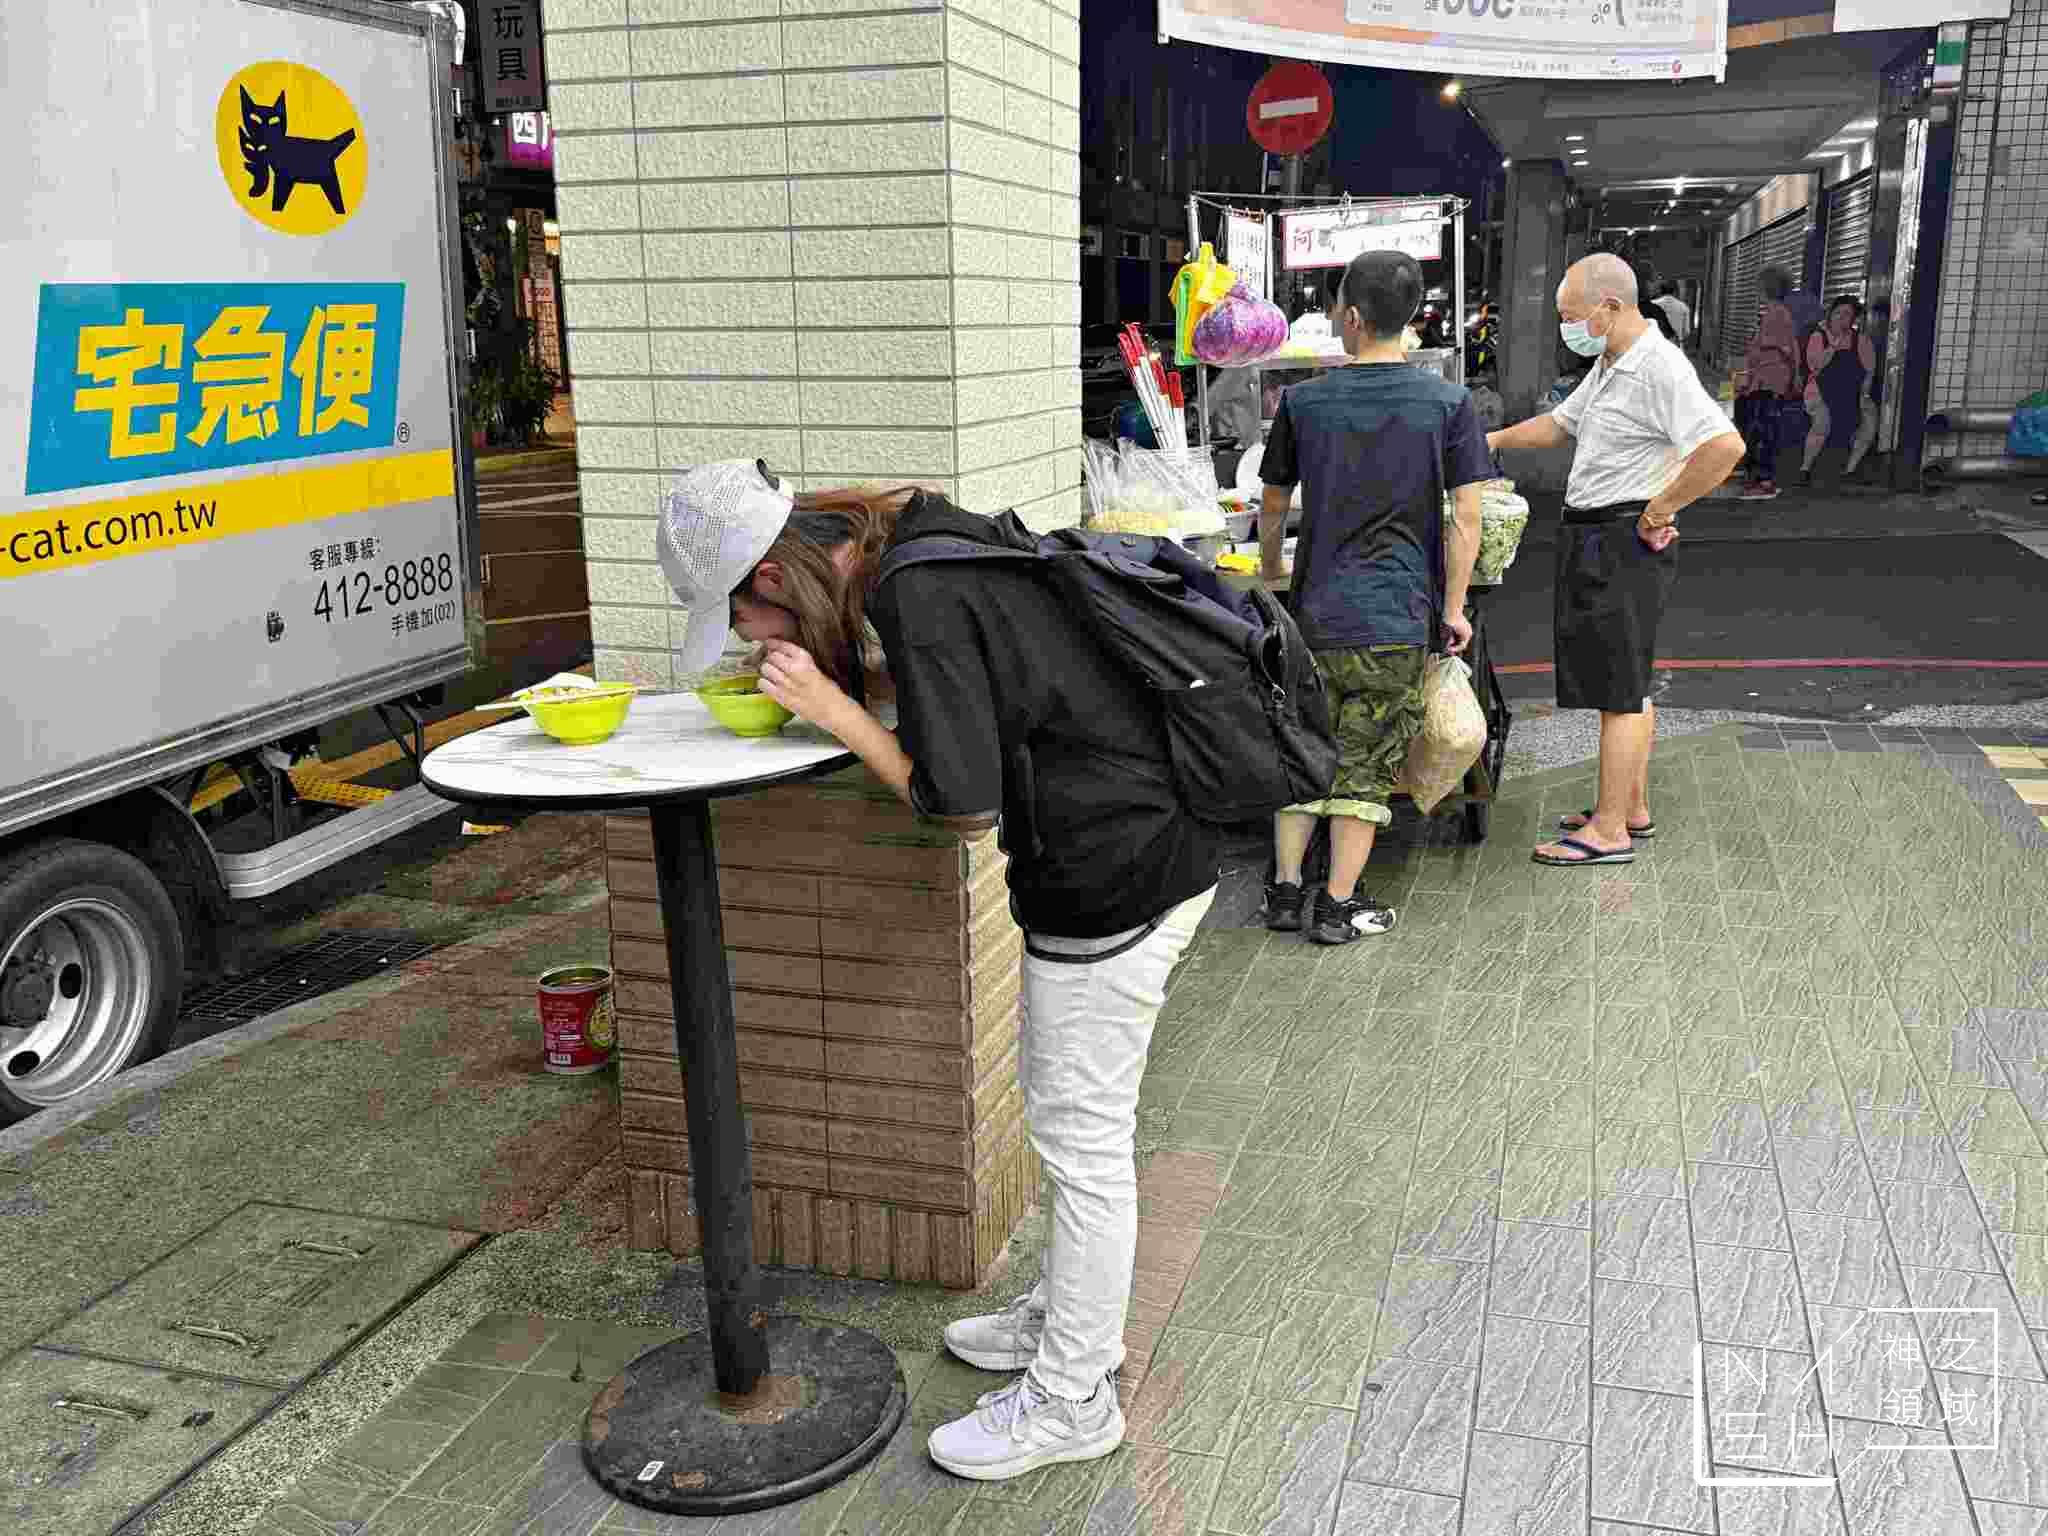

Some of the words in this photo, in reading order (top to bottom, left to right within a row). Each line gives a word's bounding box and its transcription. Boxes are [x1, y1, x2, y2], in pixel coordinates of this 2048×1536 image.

[494, 5, 528, 81] 玩具
[74, 304, 377, 459] 宅急便
[314, 553, 453, 622] 412-8888
